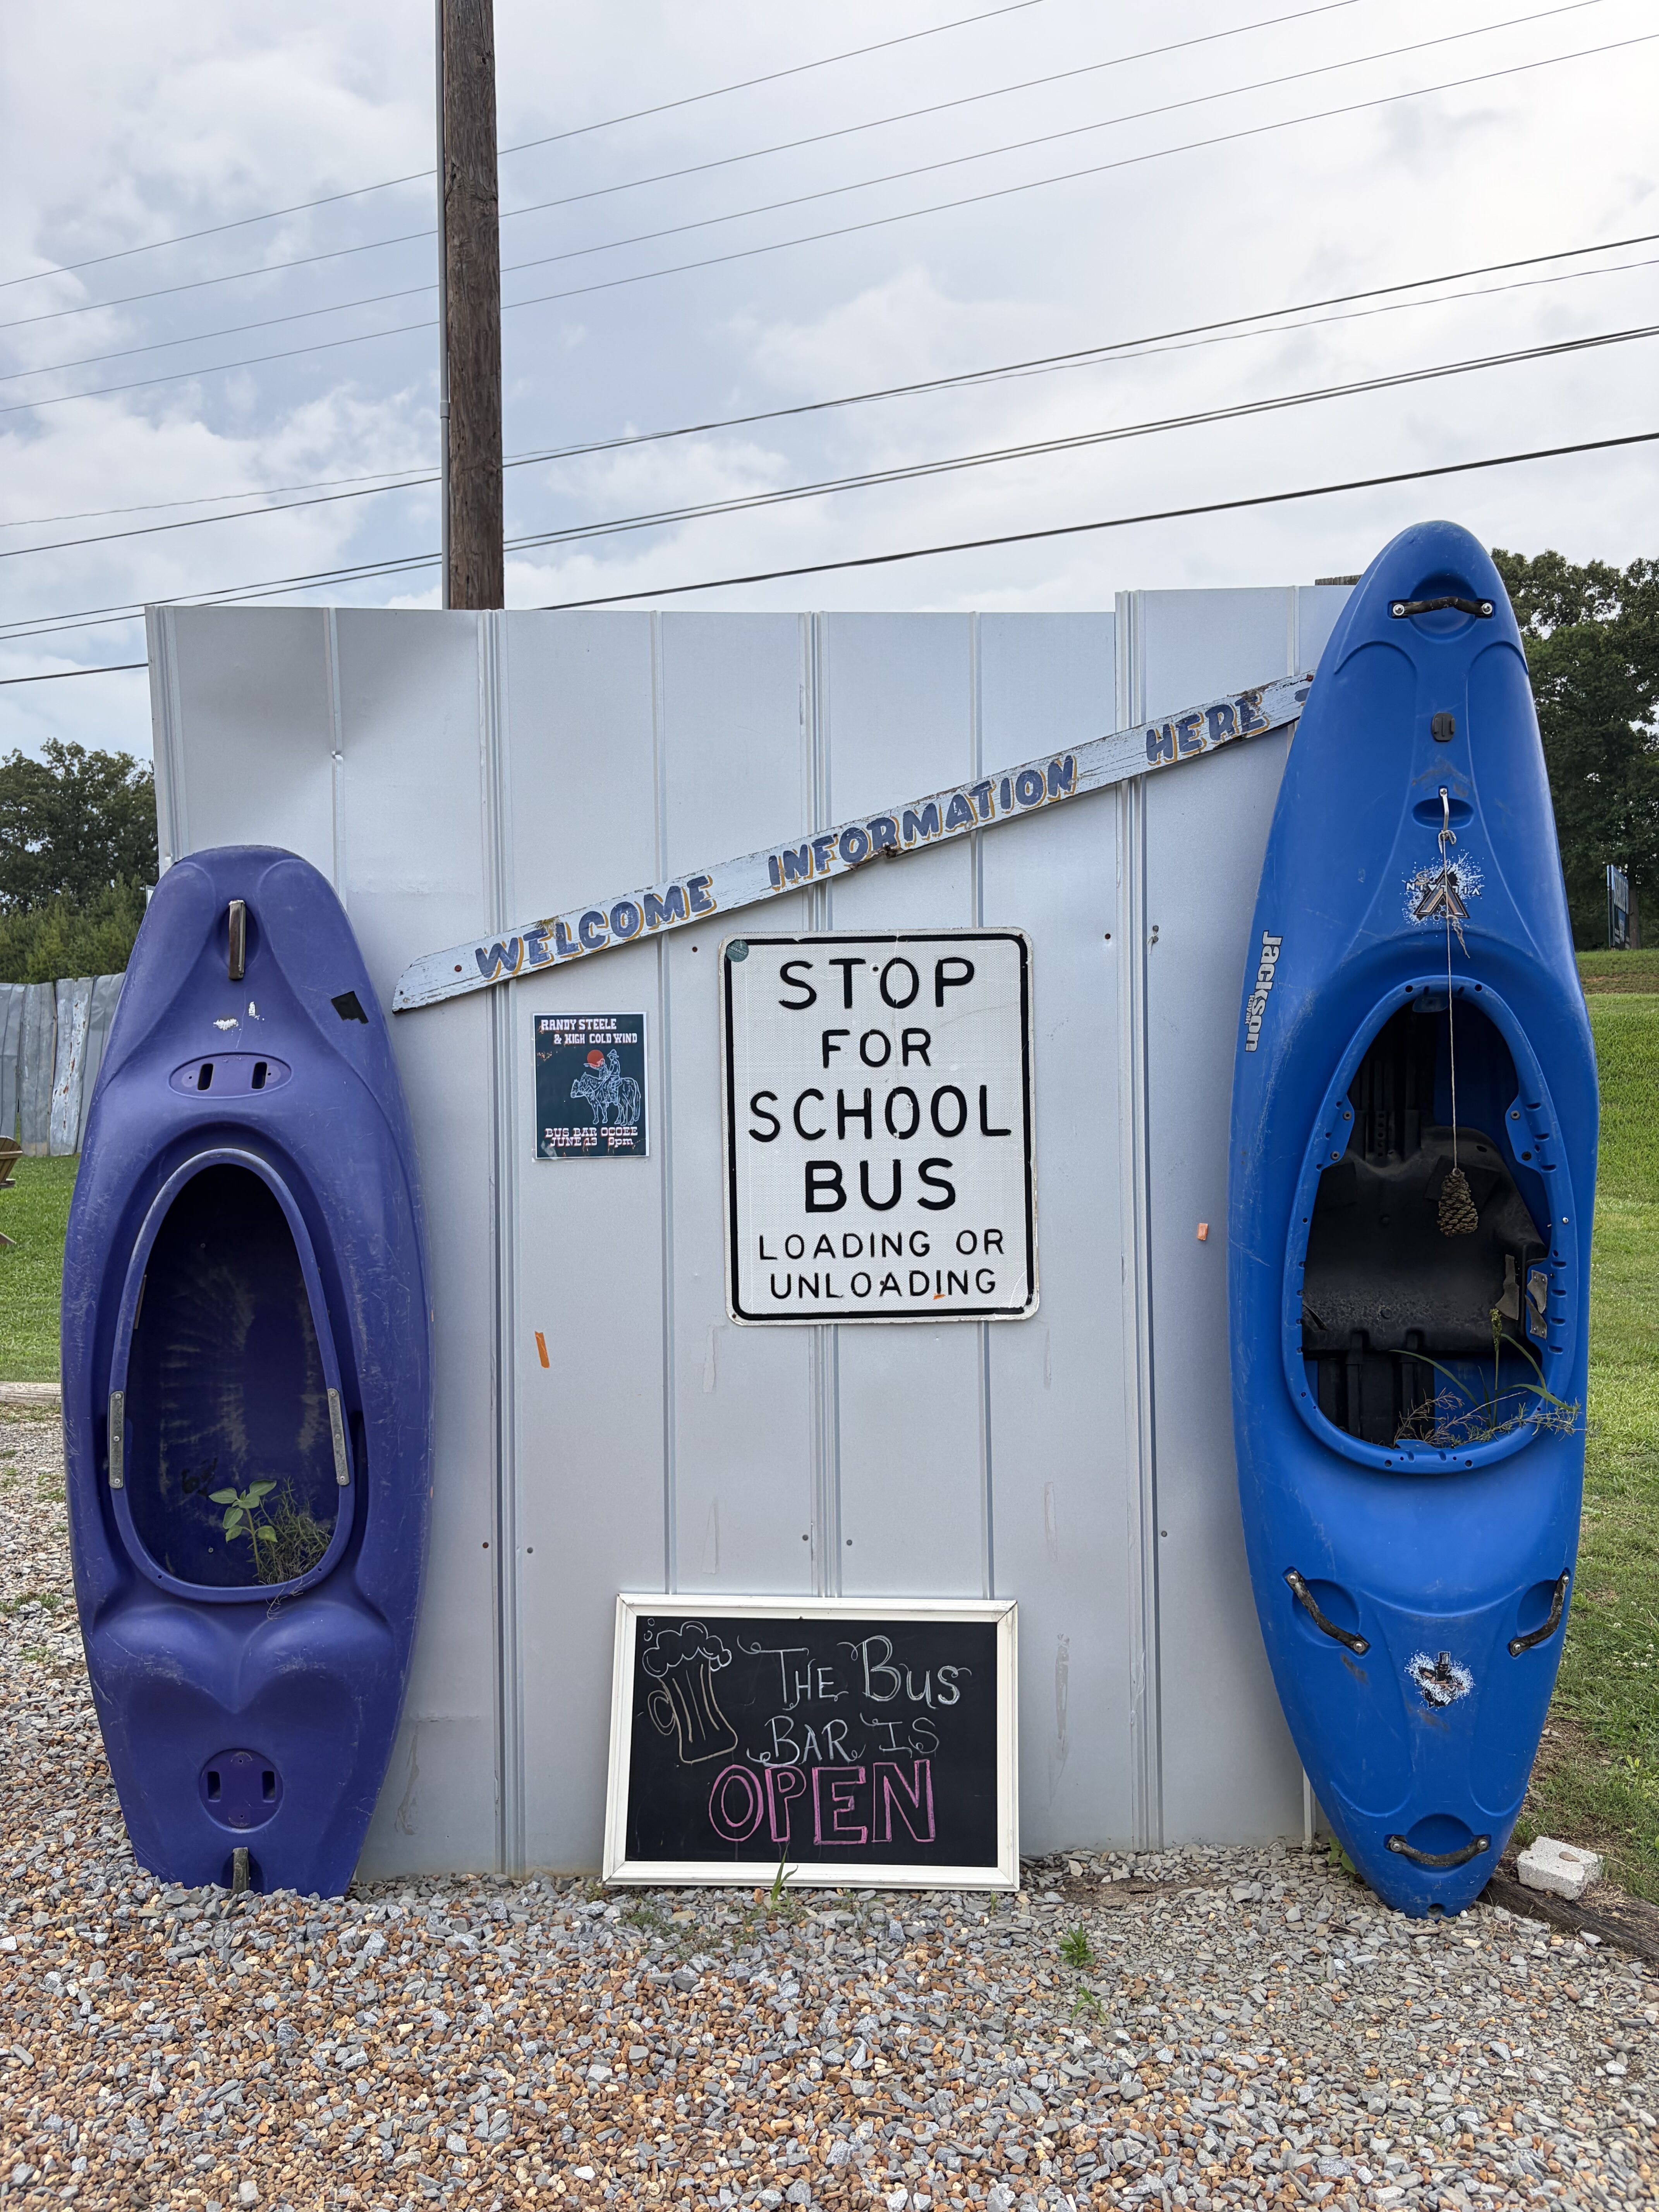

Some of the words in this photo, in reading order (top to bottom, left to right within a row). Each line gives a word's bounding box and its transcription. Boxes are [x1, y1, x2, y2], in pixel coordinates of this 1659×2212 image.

[476, 875, 716, 982] WELCOME
[768, 756, 1077, 891] INFORMATION
[1146, 692, 1269, 766] HERE
[1406, 882, 1481, 896] VILLAIN
[779, 957, 975, 1010] STOP
[1245, 930, 1283, 1052] Jackson
[541, 1019, 577, 1030] RANDY
[579, 1018, 617, 1030] STEELE
[554, 1034, 562, 1044] &
[564, 1034, 585, 1044] HIGH
[589, 1033, 611, 1044] COLD
[613, 1033, 637, 1043] WIND
[822, 1028, 931, 1068] FOR
[545, 1128, 569, 1138] BUS
[573, 1127, 597, 1137] BAR
[601, 1127, 638, 1137] OCOEE
[749, 1085, 1012, 1142] SCHOOL
[550, 1137, 582, 1147] JUNE
[585, 1137, 598, 1146] 13
[805, 1158, 956, 1212] BUS
[759, 1231, 930, 1260] LOADING
[956, 1229, 1005, 1255] OR
[771, 1268, 996, 1299] UNLOADING
[738, 1635, 848, 1710] THE
[747, 1716, 866, 1766] BAR
[860, 1713, 939, 1758] IS
[709, 1759, 936, 1845] OPEN
